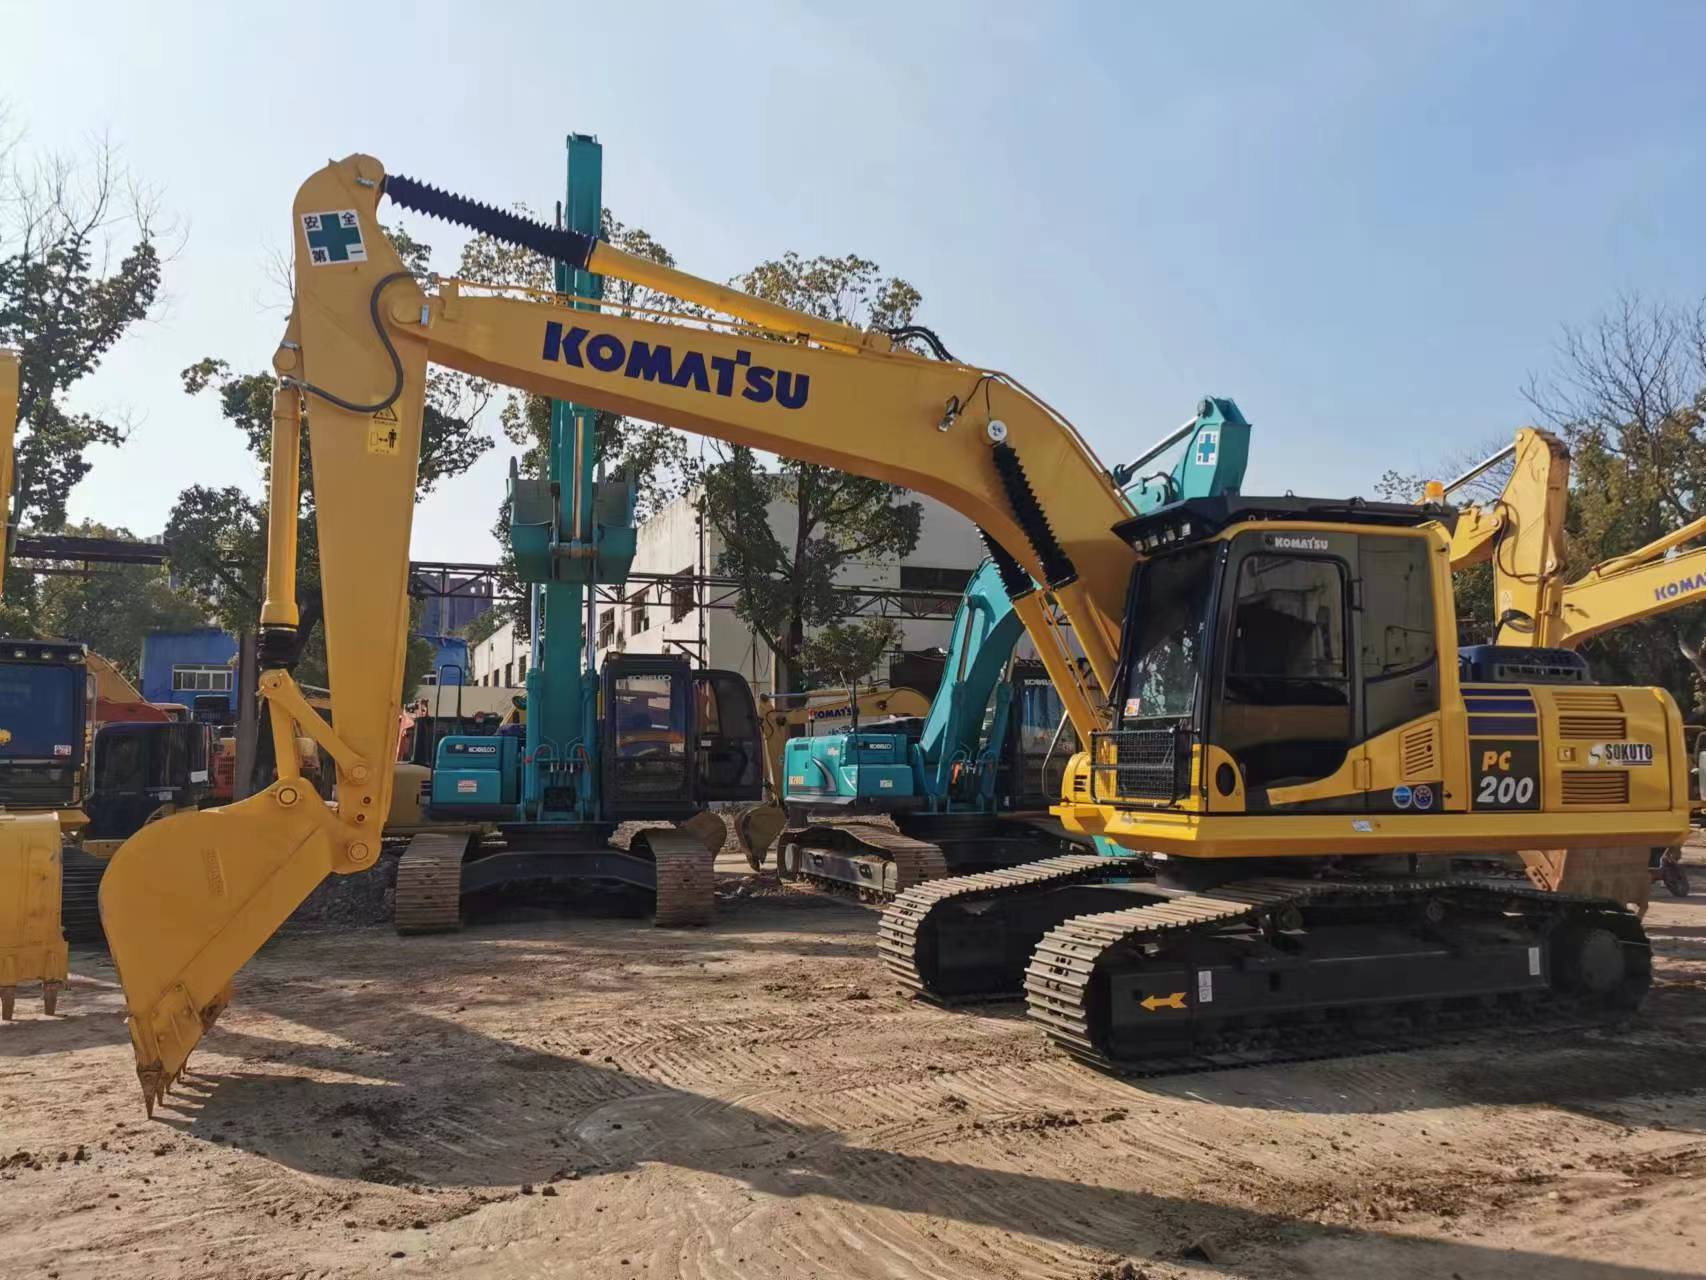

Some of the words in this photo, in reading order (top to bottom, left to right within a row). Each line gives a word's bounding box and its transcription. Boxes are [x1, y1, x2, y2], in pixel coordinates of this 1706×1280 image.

[542, 320, 810, 410] KOMATSU
[1275, 536, 1328, 550] KOMATSU
[1655, 573, 1706, 601] KOMA
[1482, 751, 1512, 772] PC
[1605, 743, 1653, 760] SOKUTO
[1476, 776, 1534, 804] 200
